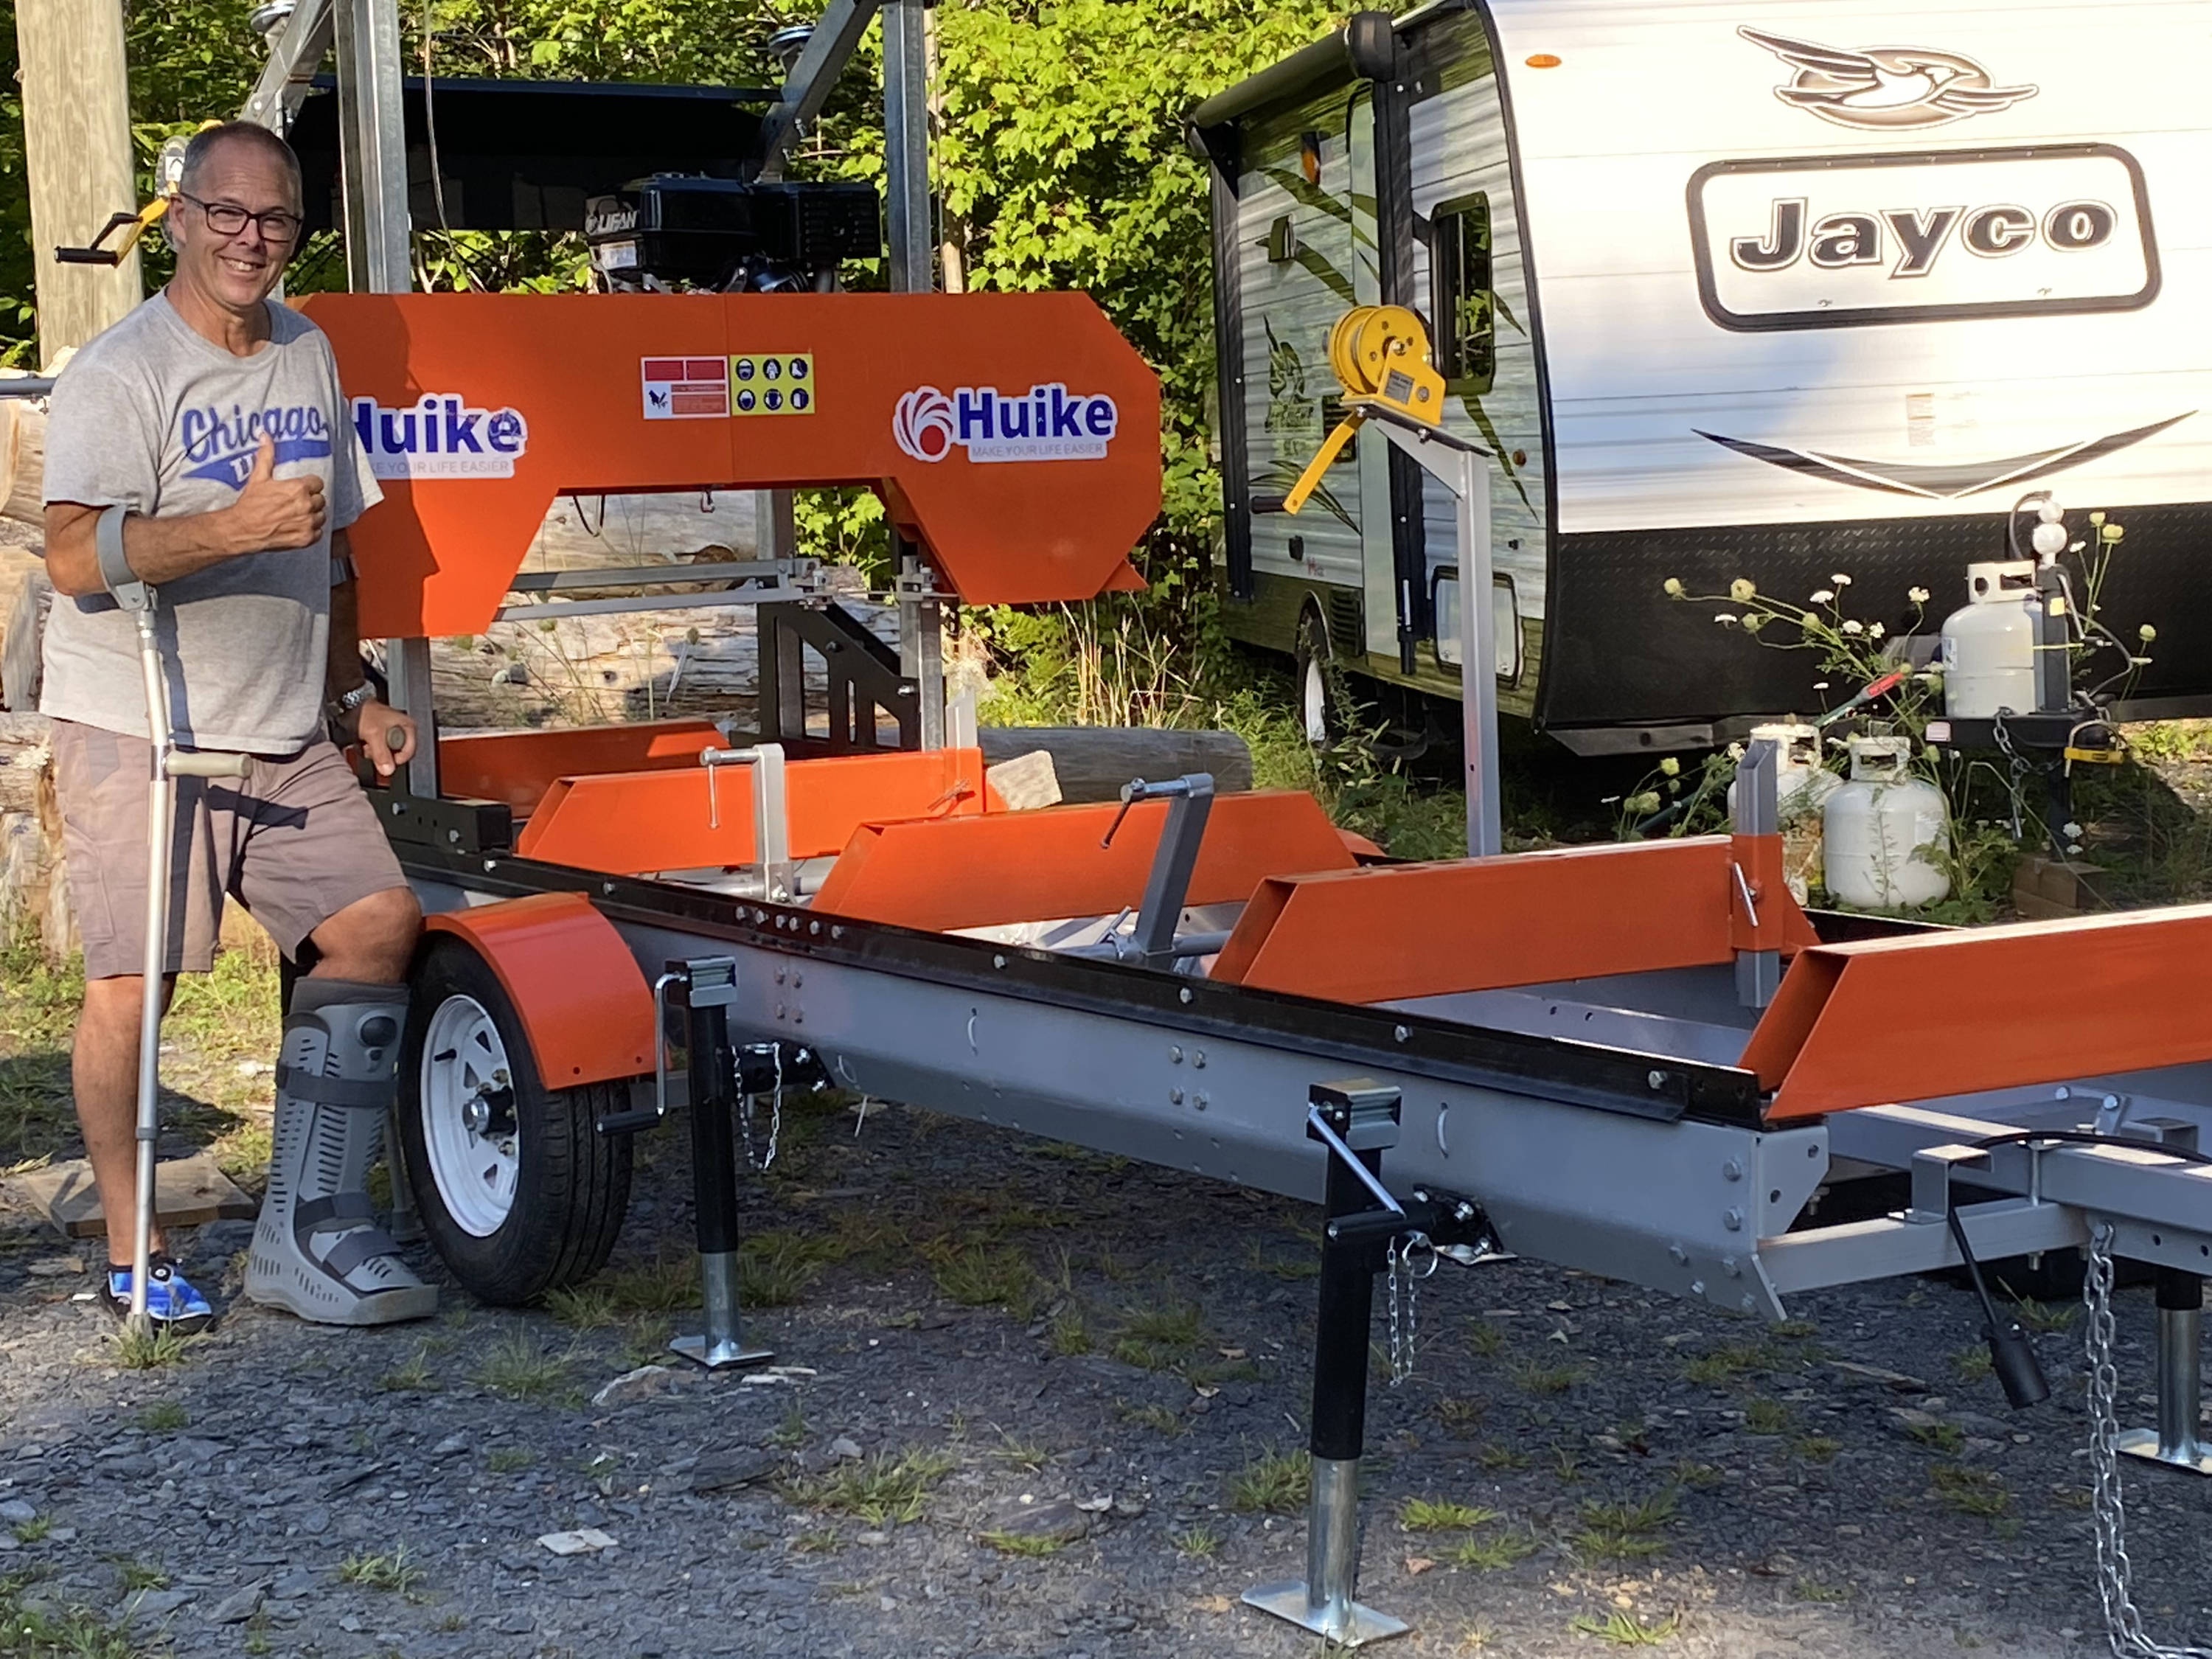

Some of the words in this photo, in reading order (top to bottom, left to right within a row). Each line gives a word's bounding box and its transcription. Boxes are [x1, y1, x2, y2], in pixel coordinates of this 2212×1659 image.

[1730, 197, 2118, 280] Jayco
[183, 405, 330, 462] Chicago
[959, 389, 1113, 439] Huike
[430, 461, 457, 473] LIFE
[461, 460, 509, 473] EASIER
[972, 446, 1004, 456] MAKE
[1006, 445, 1037, 456] YOUR
[1039, 445, 1062, 455] LIFE
[1064, 443, 1104, 454] EASIER
